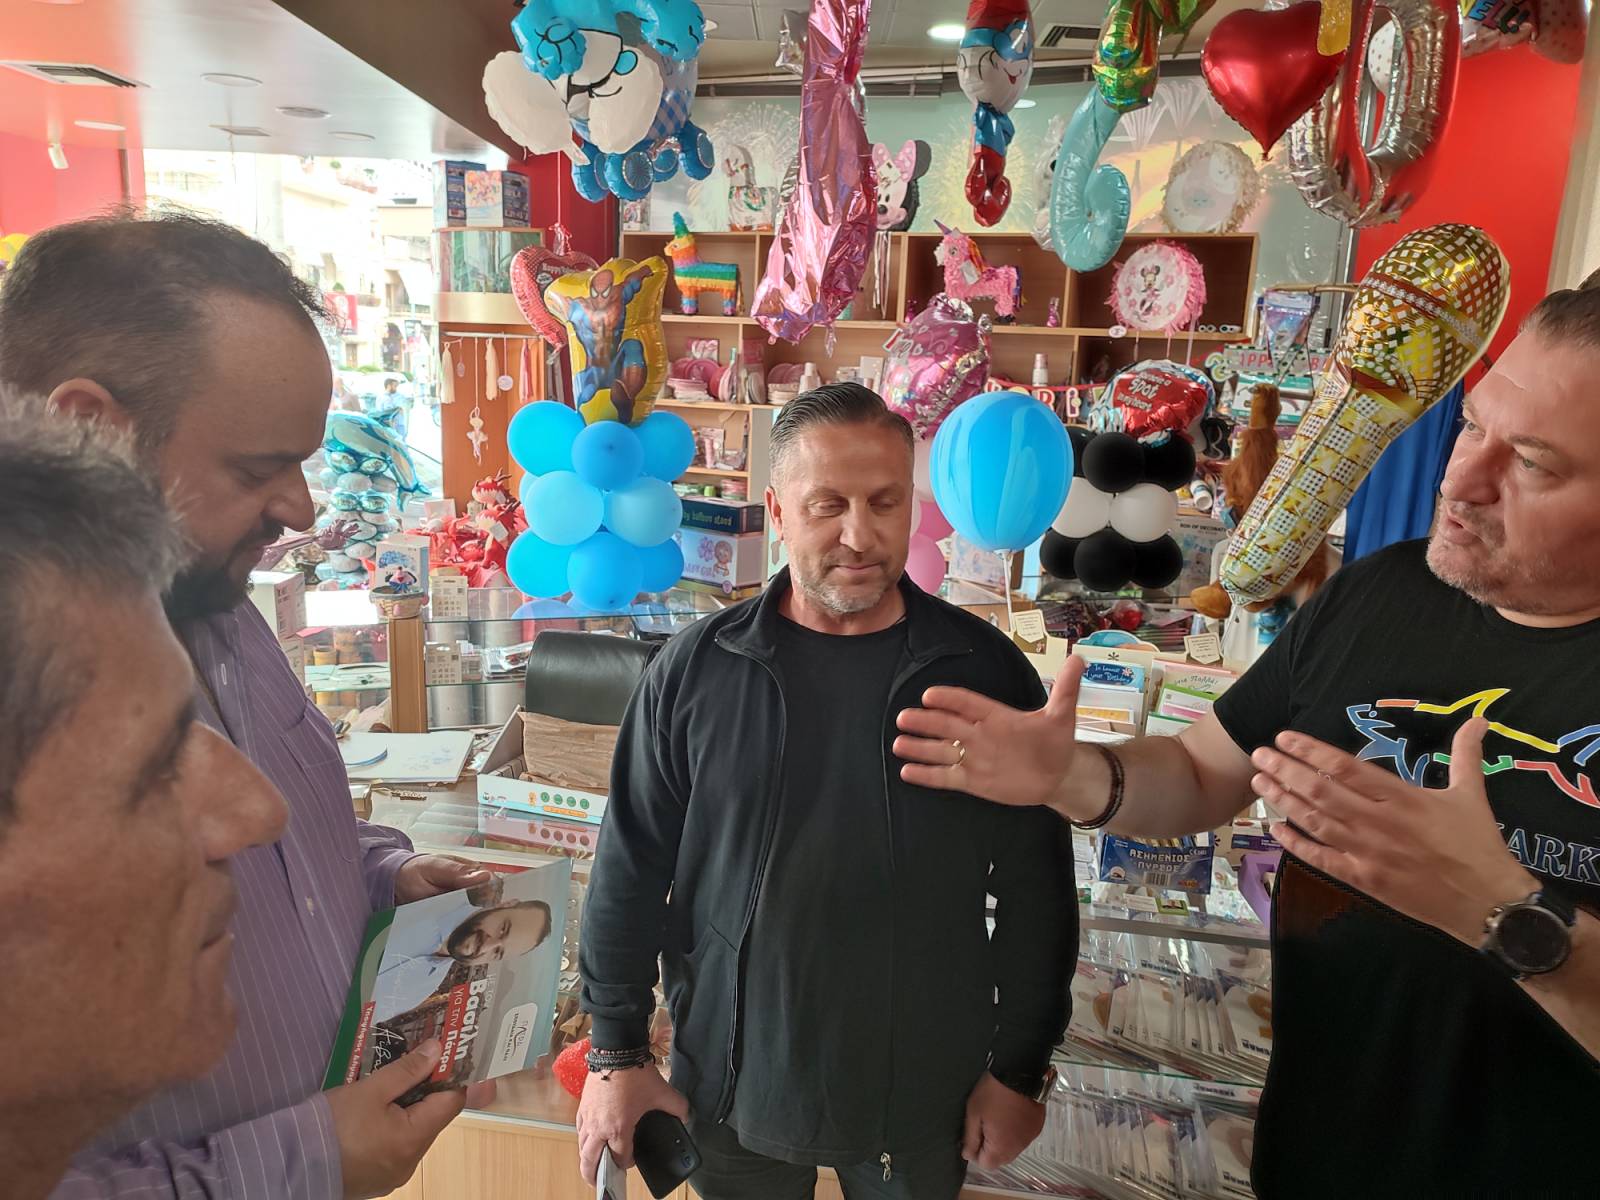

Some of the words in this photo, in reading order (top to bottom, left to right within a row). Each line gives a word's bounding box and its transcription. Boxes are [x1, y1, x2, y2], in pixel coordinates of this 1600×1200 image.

[1128, 378, 1160, 400] spot
[714, 513, 733, 526] stand
[1129, 848, 1191, 863] ΑΣΗΜΕΝΙΟΣ
[1498, 824, 1600, 886] ARK
[1138, 861, 1181, 873] ΠΥΡΣΟΣ
[454, 988, 465, 1005] για
[449, 1007, 461, 1027] την
[454, 979, 488, 1060] Βασίλη
[438, 1030, 459, 1073] Πάτρα
